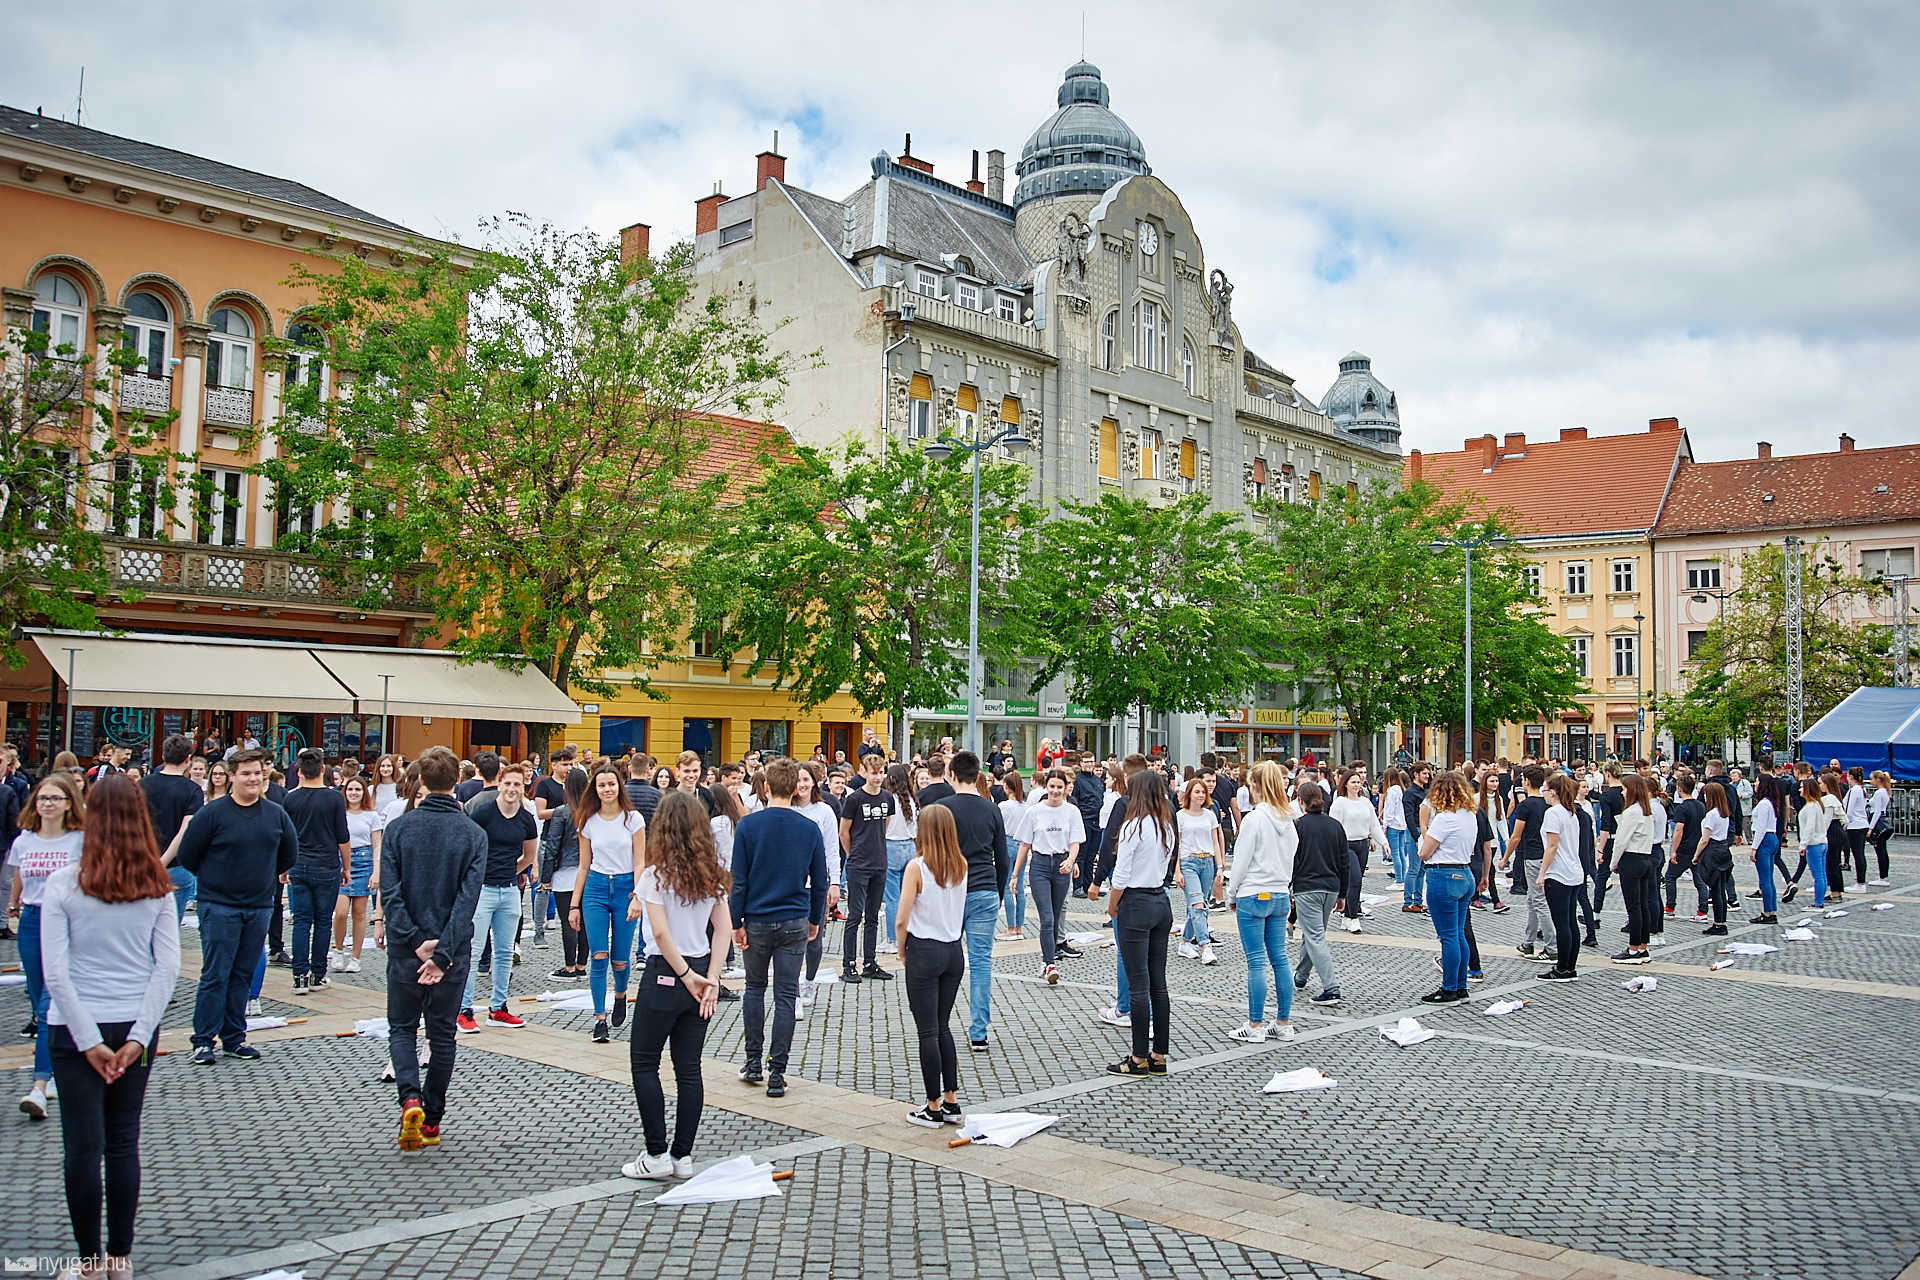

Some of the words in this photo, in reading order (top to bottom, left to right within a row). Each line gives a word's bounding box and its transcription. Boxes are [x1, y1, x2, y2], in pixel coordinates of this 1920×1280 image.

[984, 704, 998, 712] BENU
[1047, 706, 1059, 714] BENU
[1255, 711, 1289, 722] FAMILY
